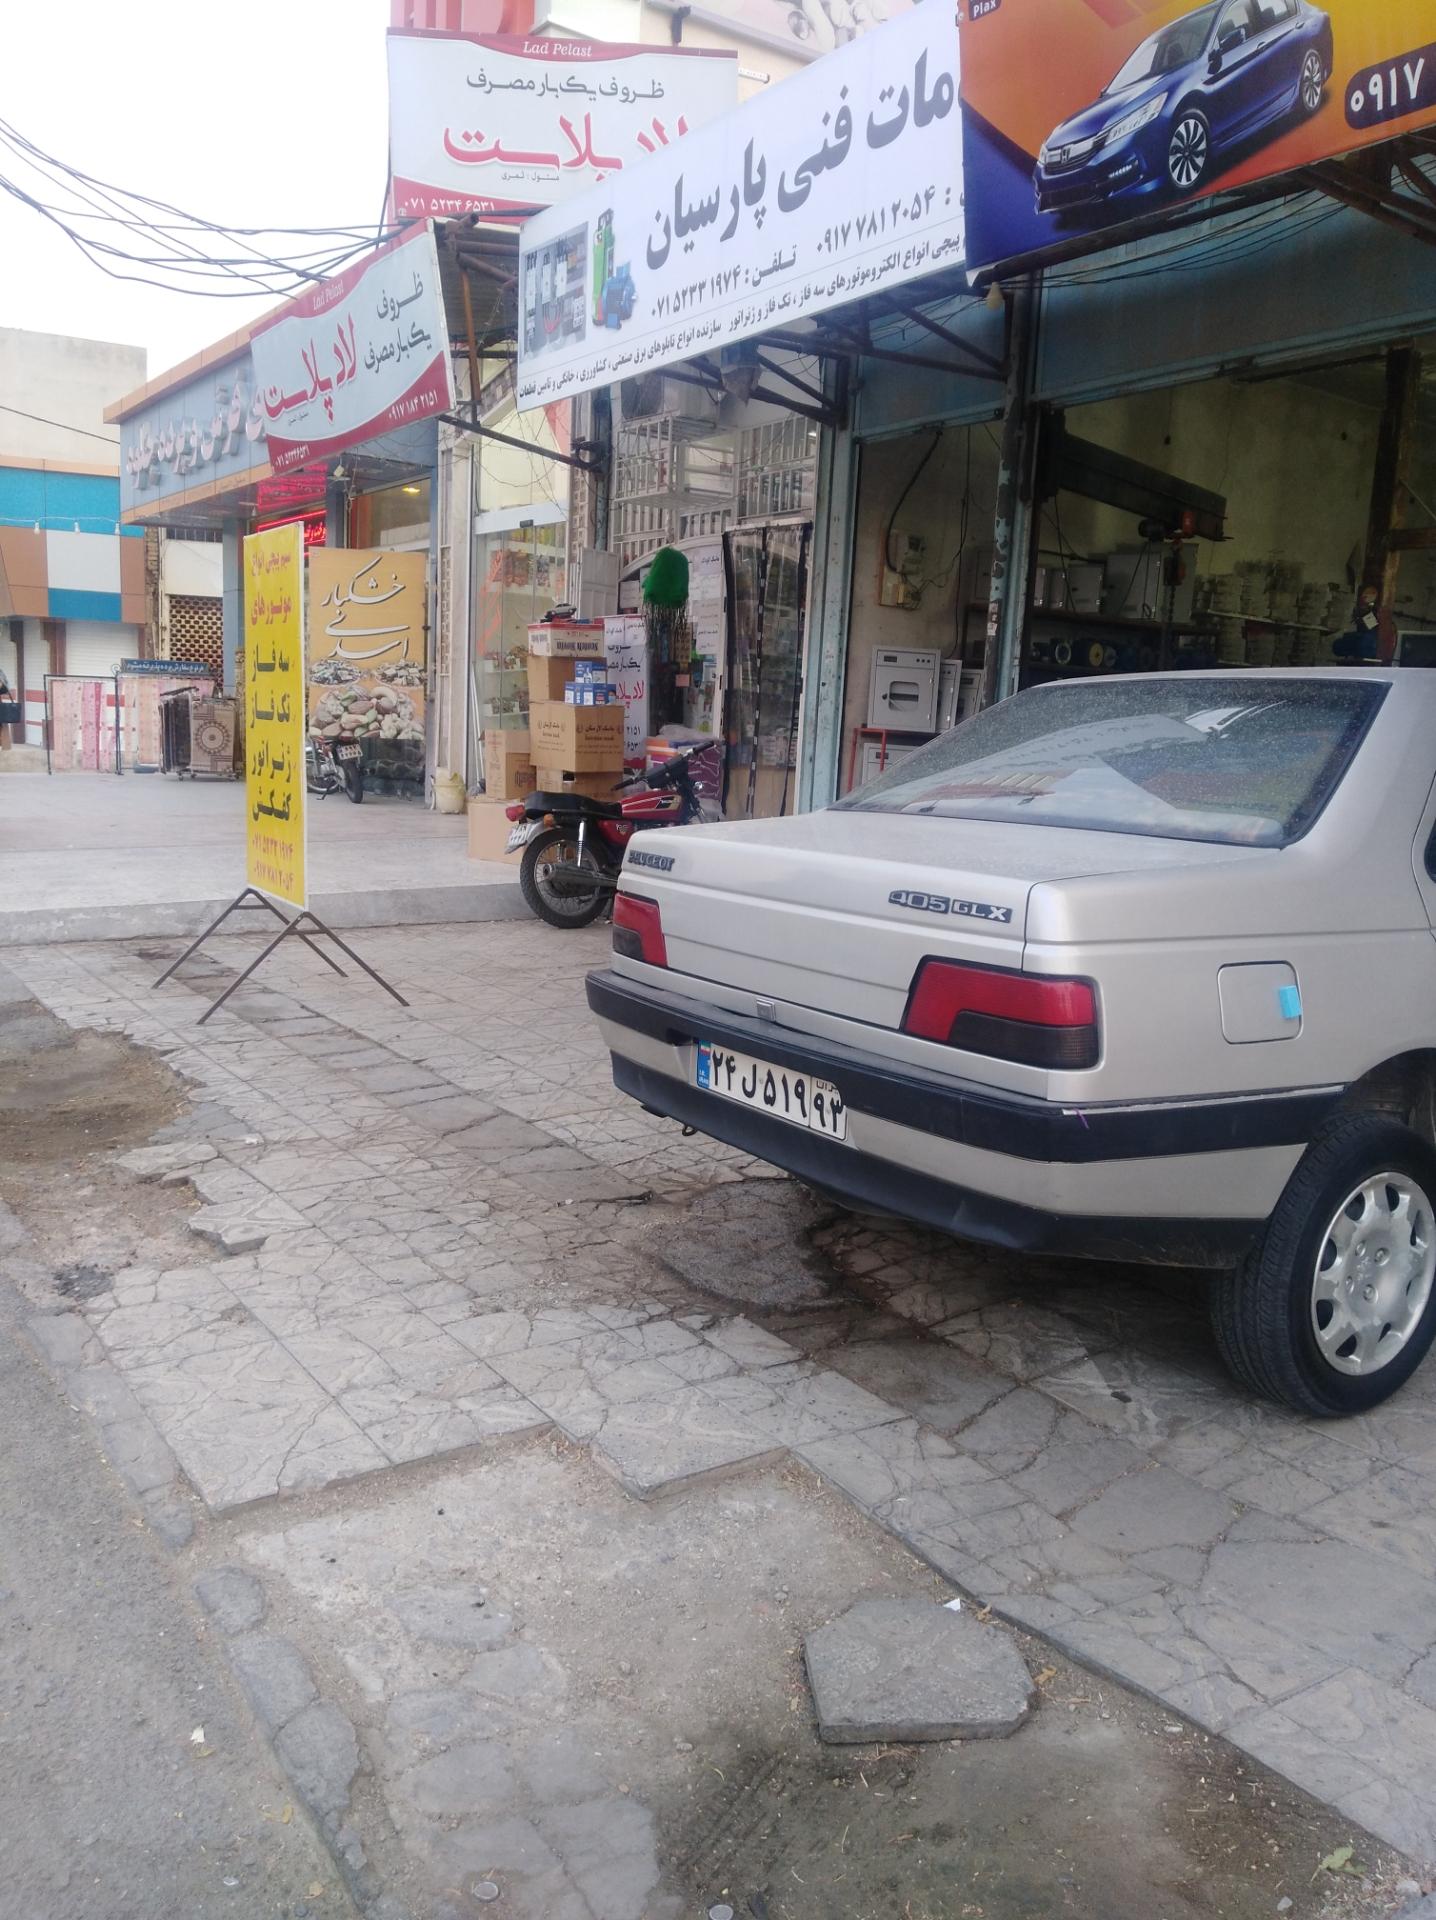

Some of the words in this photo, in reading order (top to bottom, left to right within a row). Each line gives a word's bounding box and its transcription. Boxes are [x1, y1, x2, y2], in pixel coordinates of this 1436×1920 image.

[523, 42, 550, 55] Lad
[552, 43, 593, 58] Pelast
[466, 68, 535, 96] مصرف
[600, 79, 665, 103] ظروف
[866, 46, 963, 150] مات
[777, 84, 853, 213] فنی
[404, 198, 425, 209] ۰۷۱
[646, 136, 768, 270] پارسیان
[817, 222, 852, 253] ۰۹۱۷
[856, 206, 885, 242] ۷۸۱
[891, 185, 936, 228] ۲۰۵۴
[903, 241, 930, 270] انواع
[932, 233, 961, 259] پیچی
[377, 271, 424, 322] ظروف
[651, 296, 671, 319] ۰۷۱
[673, 281, 707, 314] ۵۲۳۳
[710, 264, 742, 299] ۱۹۷۴
[777, 292, 791, 311] تک
[813, 284, 826, 296] سه
[728, 306, 756, 332] ژنراتور
[763, 297, 777, 321] فاز
[677, 330, 695, 350] انواع
[696, 321, 722, 341] سازنده
[336, 311, 358, 385] لاد
[365, 343, 395, 374] مصرف
[633, 346, 647, 364] برق
[263, 338, 333, 424] پلاست
[320, 554, 407, 607] خشکبار
[251, 641, 277, 682] فاز
[277, 645, 291, 673] سه
[250, 688, 276, 729] فاز
[277, 690, 291, 724] تک
[251, 785, 293, 822] کفکش
[889, 890, 949, 914] 405
[952, 900, 1010, 923] GLX
[711, 1049, 737, 1091] ۲۴
[742, 1063, 757, 1099] ل
[763, 1068, 808, 1119] ۵۱۹
[813, 1092, 845, 1133] ۹۳
